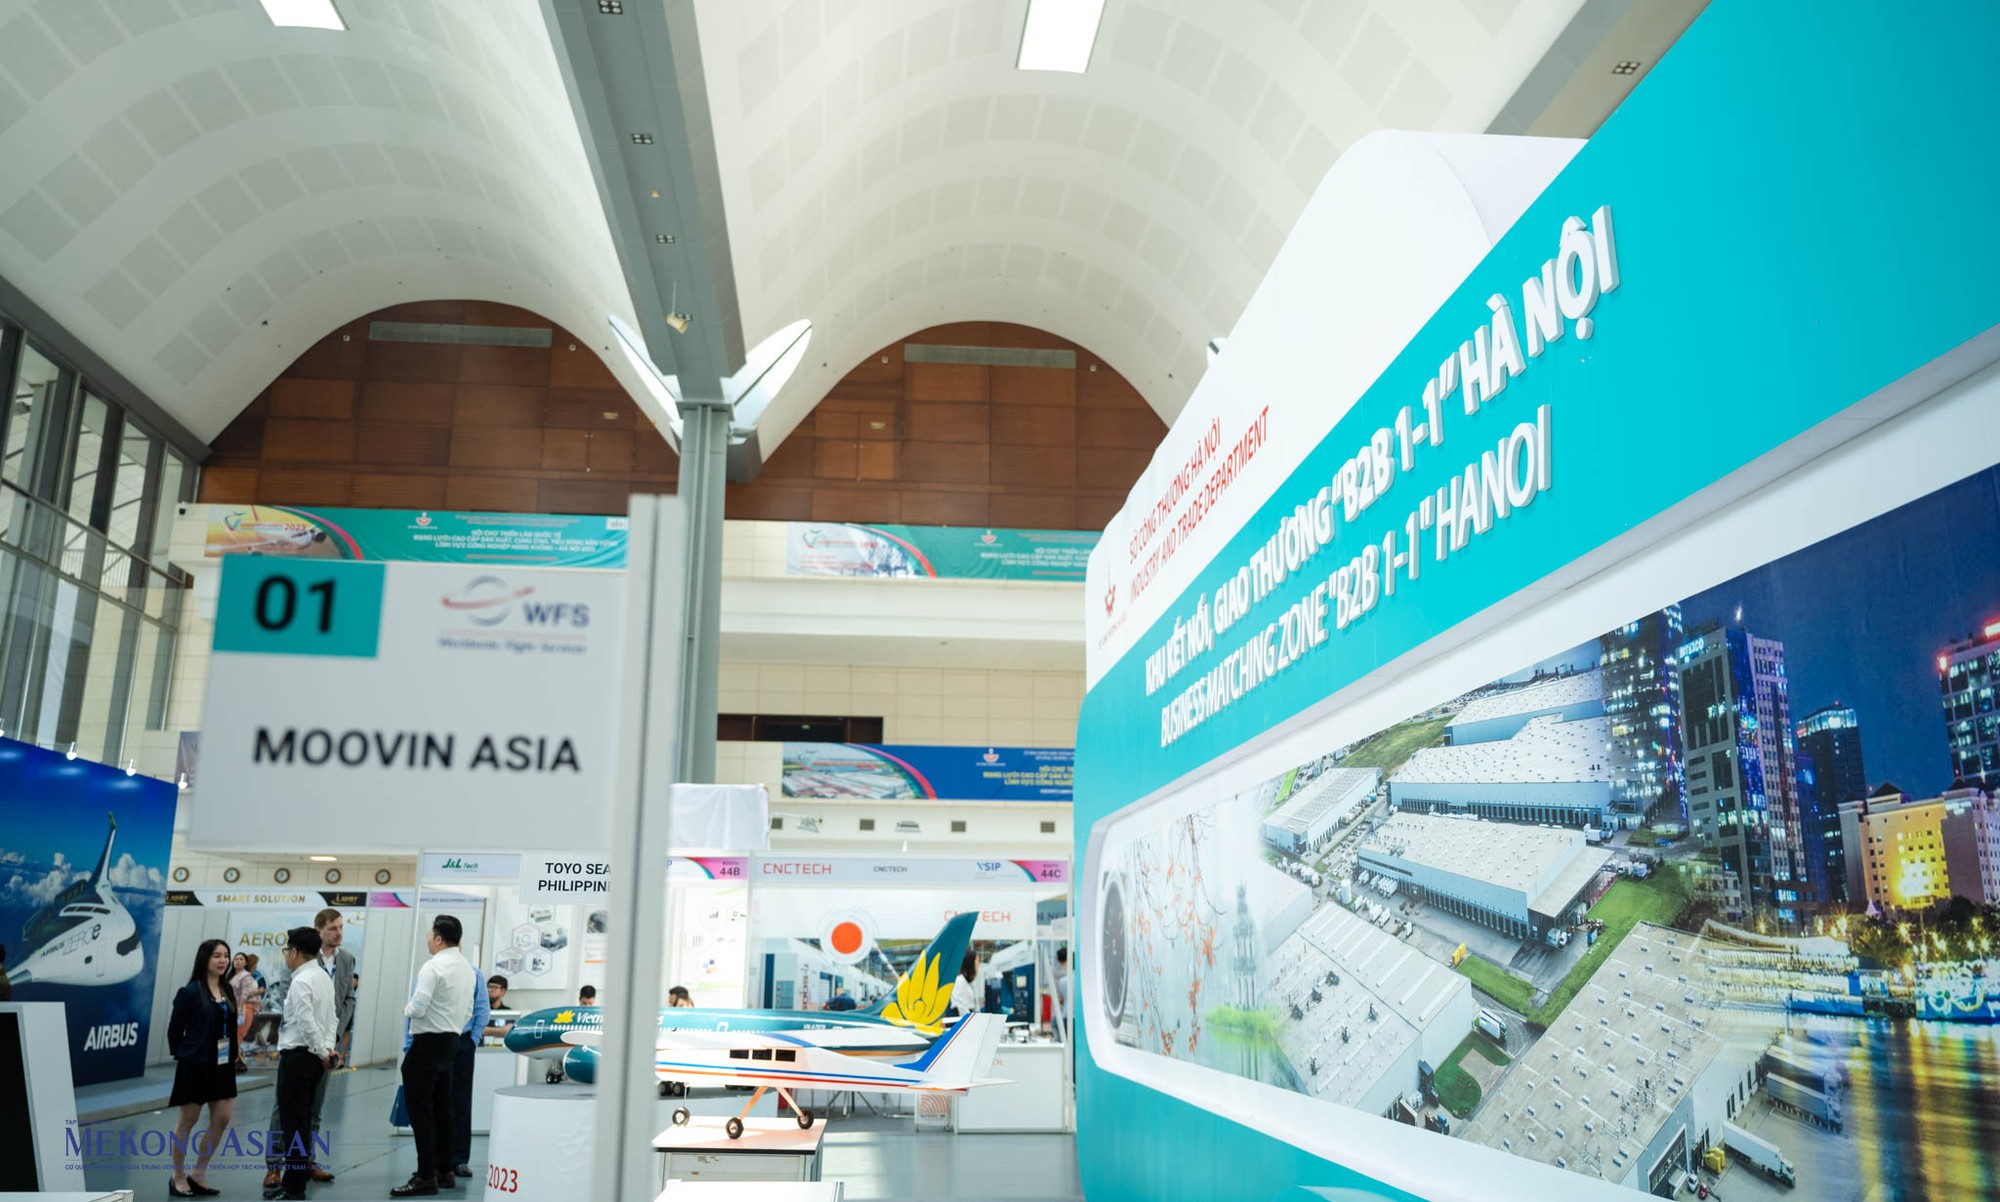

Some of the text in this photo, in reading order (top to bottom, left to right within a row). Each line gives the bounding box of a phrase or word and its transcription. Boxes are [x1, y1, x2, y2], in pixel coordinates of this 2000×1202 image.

[1145, 645, 1168, 697] KHU
[1214, 566, 1251, 635] GIAO
[1459, 293, 1527, 416] HÀ
[1522, 205, 1621, 358] NỘI
[1139, 509, 1157, 551] CÔNG
[1157, 462, 1191, 526] THƯƠNG
[1191, 440, 1204, 483] HÀ
[1204, 417, 1221, 461] NỘI
[1130, 404, 1269, 603] INDUSTRY AND TRADE DEPARTMENT
[1160, 676, 1208, 748] BUSINESS
[1206, 622, 1279, 719] MATCHING
[1278, 580, 1329, 671] ZONE
[1436, 404, 1552, 561] HANOI
[254, 574, 337, 633] 01
[523, 602, 590, 628] WFS
[253, 726, 582, 773] MOOVIN ASIA
[545, 862, 582, 874] TOYO
[720, 867, 741, 876] 44B
[763, 863, 832, 875] CNCTECH
[1041, 869, 1062, 879] 44C
[217, 893, 306, 904] SMART SOLUTION
[84, 1022, 139, 1052] AIRBUS
[488, 1164, 518, 1193] 2023
